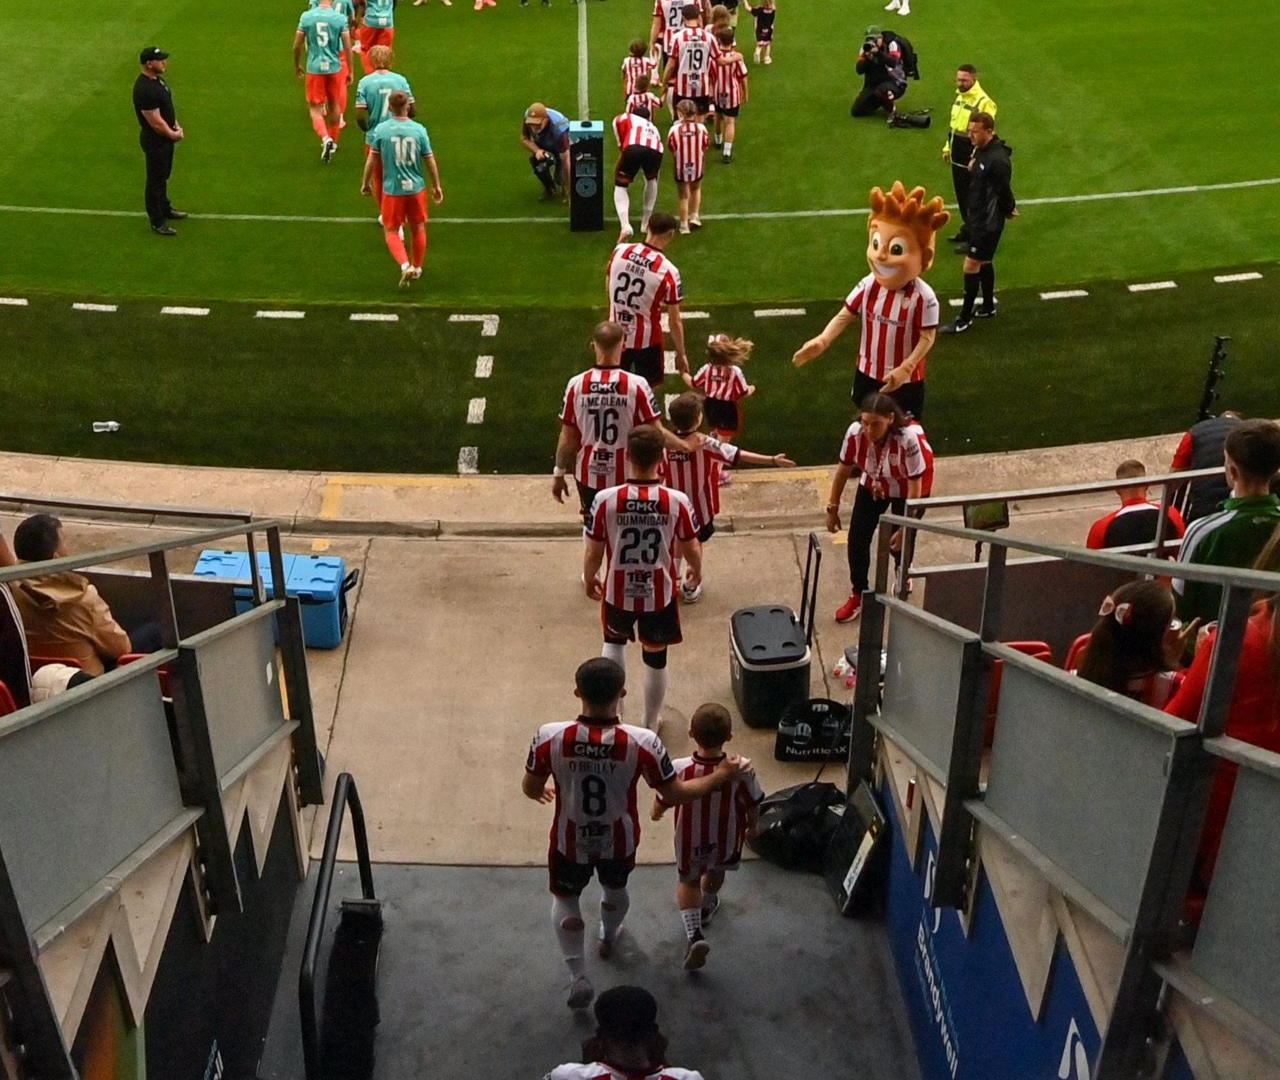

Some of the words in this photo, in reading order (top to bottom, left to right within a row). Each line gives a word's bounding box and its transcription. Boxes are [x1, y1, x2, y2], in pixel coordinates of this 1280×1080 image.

[315, 21, 329, 47] 5
[686, 48, 704, 71] 19
[378, 87, 392, 117] 7
[390, 135, 417, 166] 10
[624, 262, 646, 278] BARR
[613, 271, 646, 310] 22
[589, 381, 616, 394] GMK
[587, 407, 620, 446] 16
[625, 500, 656, 512] GMK
[619, 526, 662, 565] 23
[574, 744, 610, 758] GMK
[581, 774, 607, 817] 8
[917, 920, 959, 1080] Brandywell
